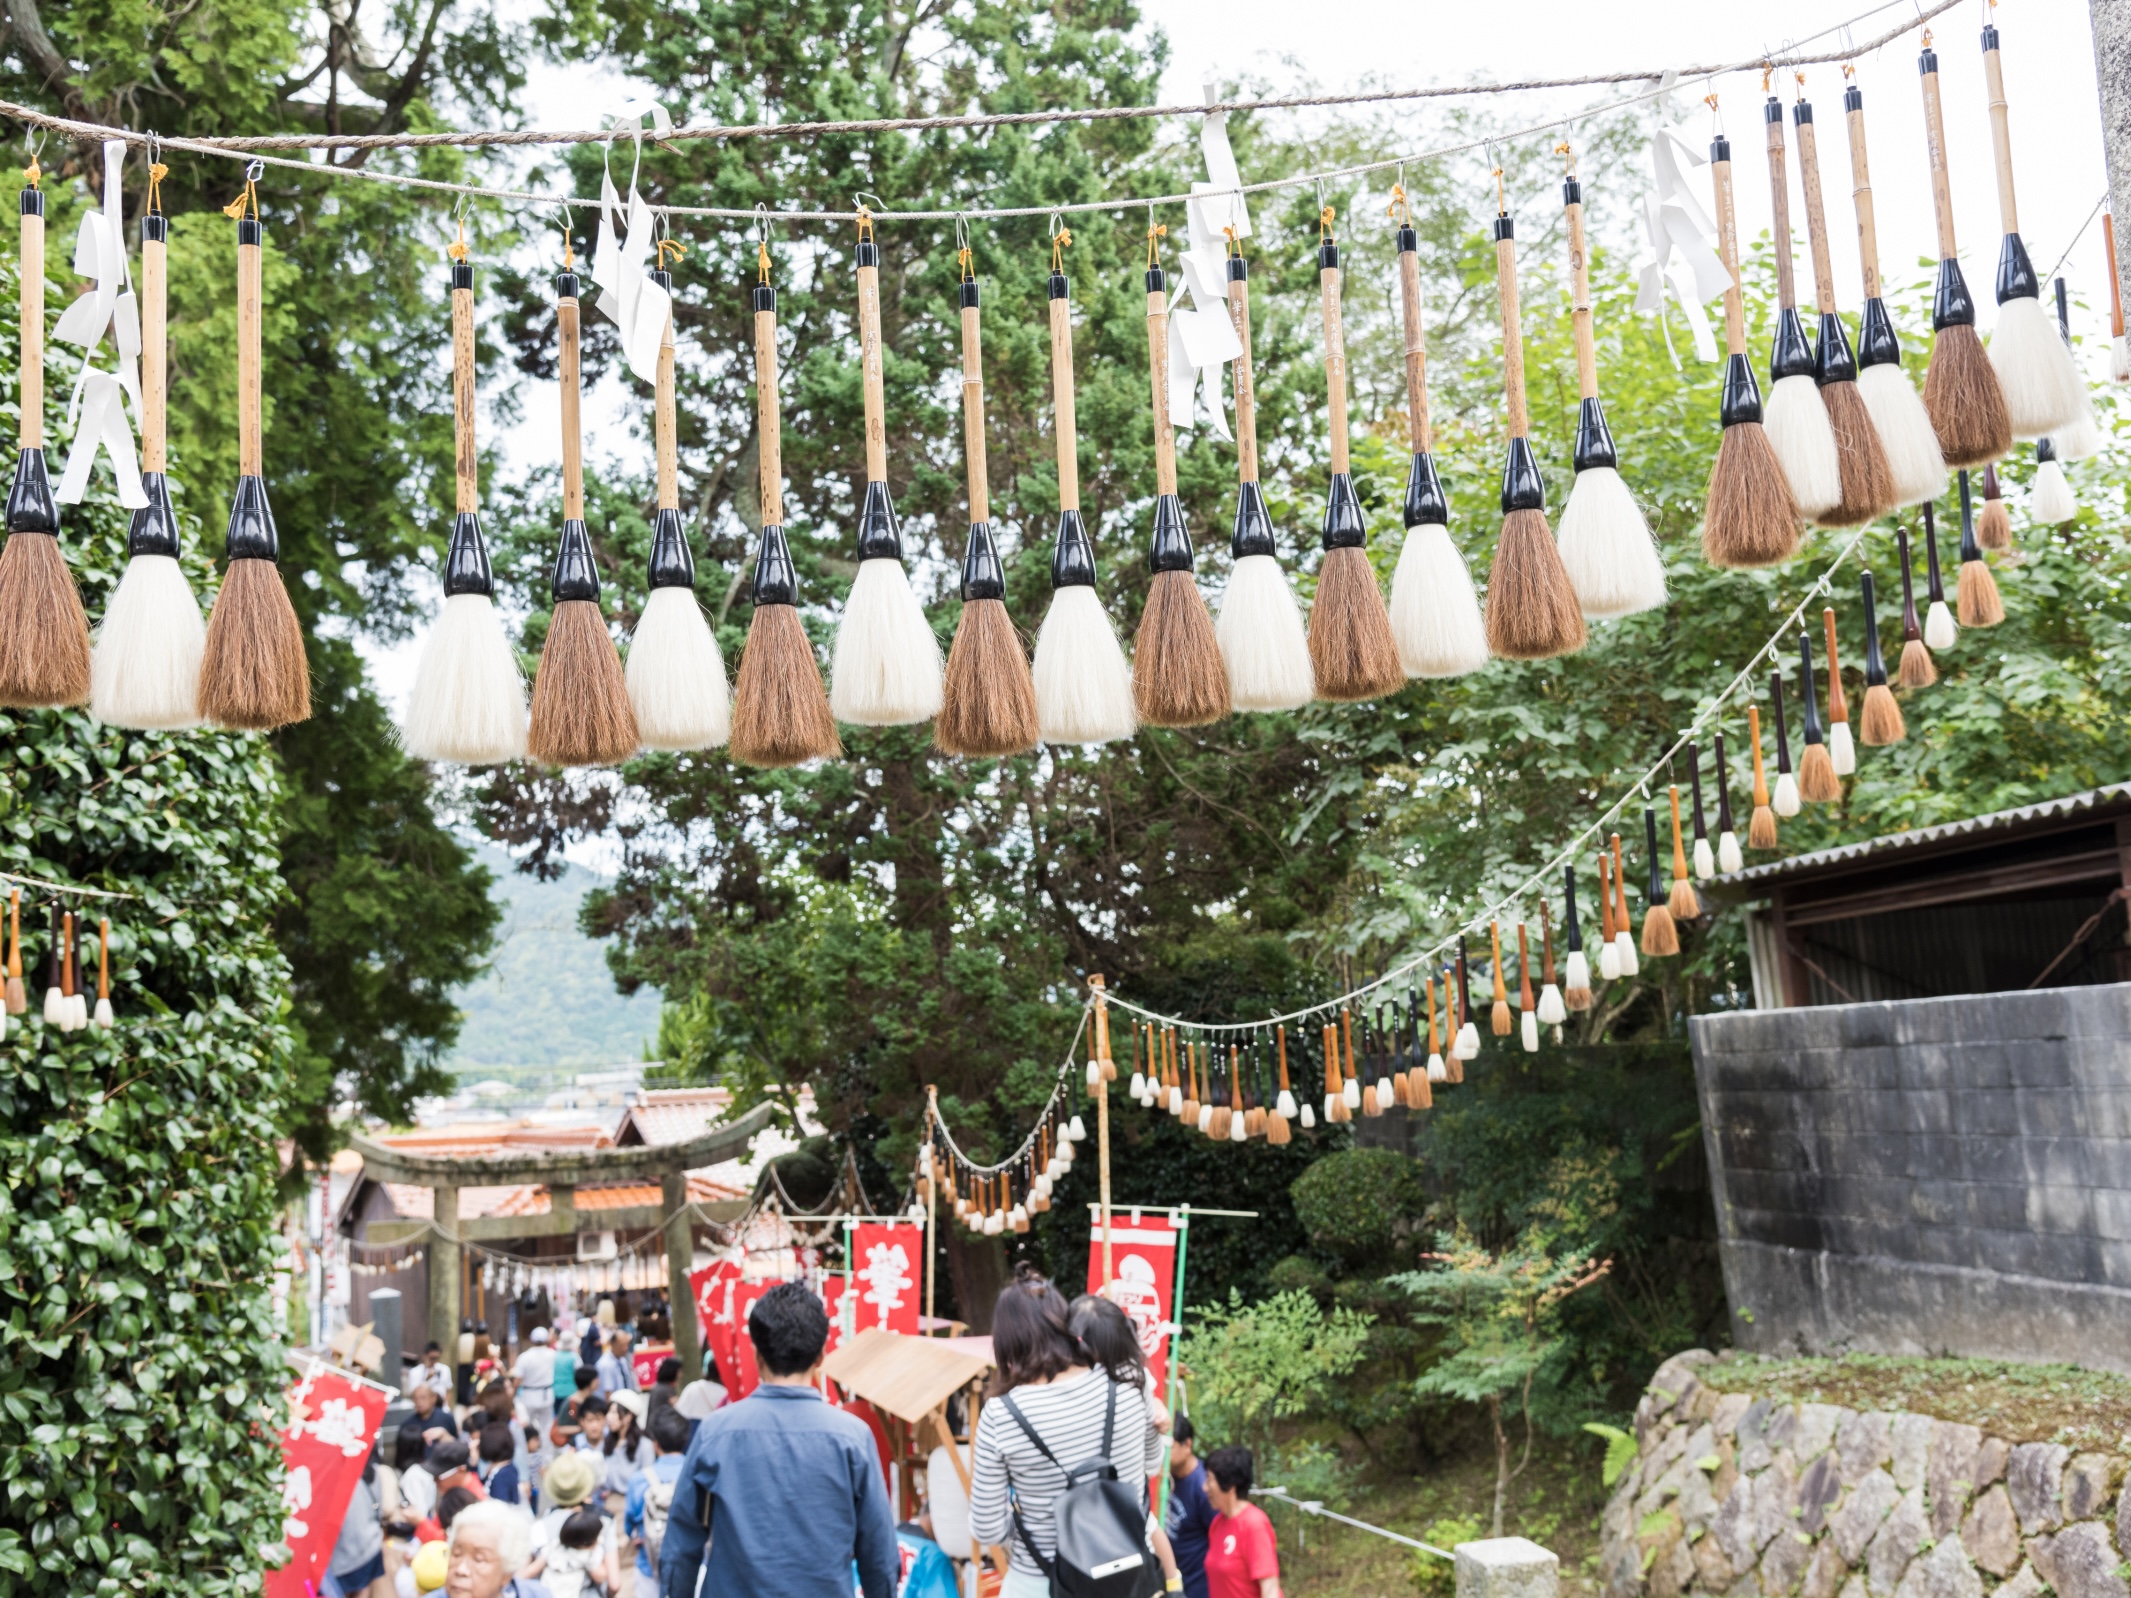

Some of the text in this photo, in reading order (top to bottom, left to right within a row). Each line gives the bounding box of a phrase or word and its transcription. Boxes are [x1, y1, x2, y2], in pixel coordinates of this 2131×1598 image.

[1327, 282, 1342, 376] 筆まつり実行委員会
[857, 1242, 913, 1335] 筆
